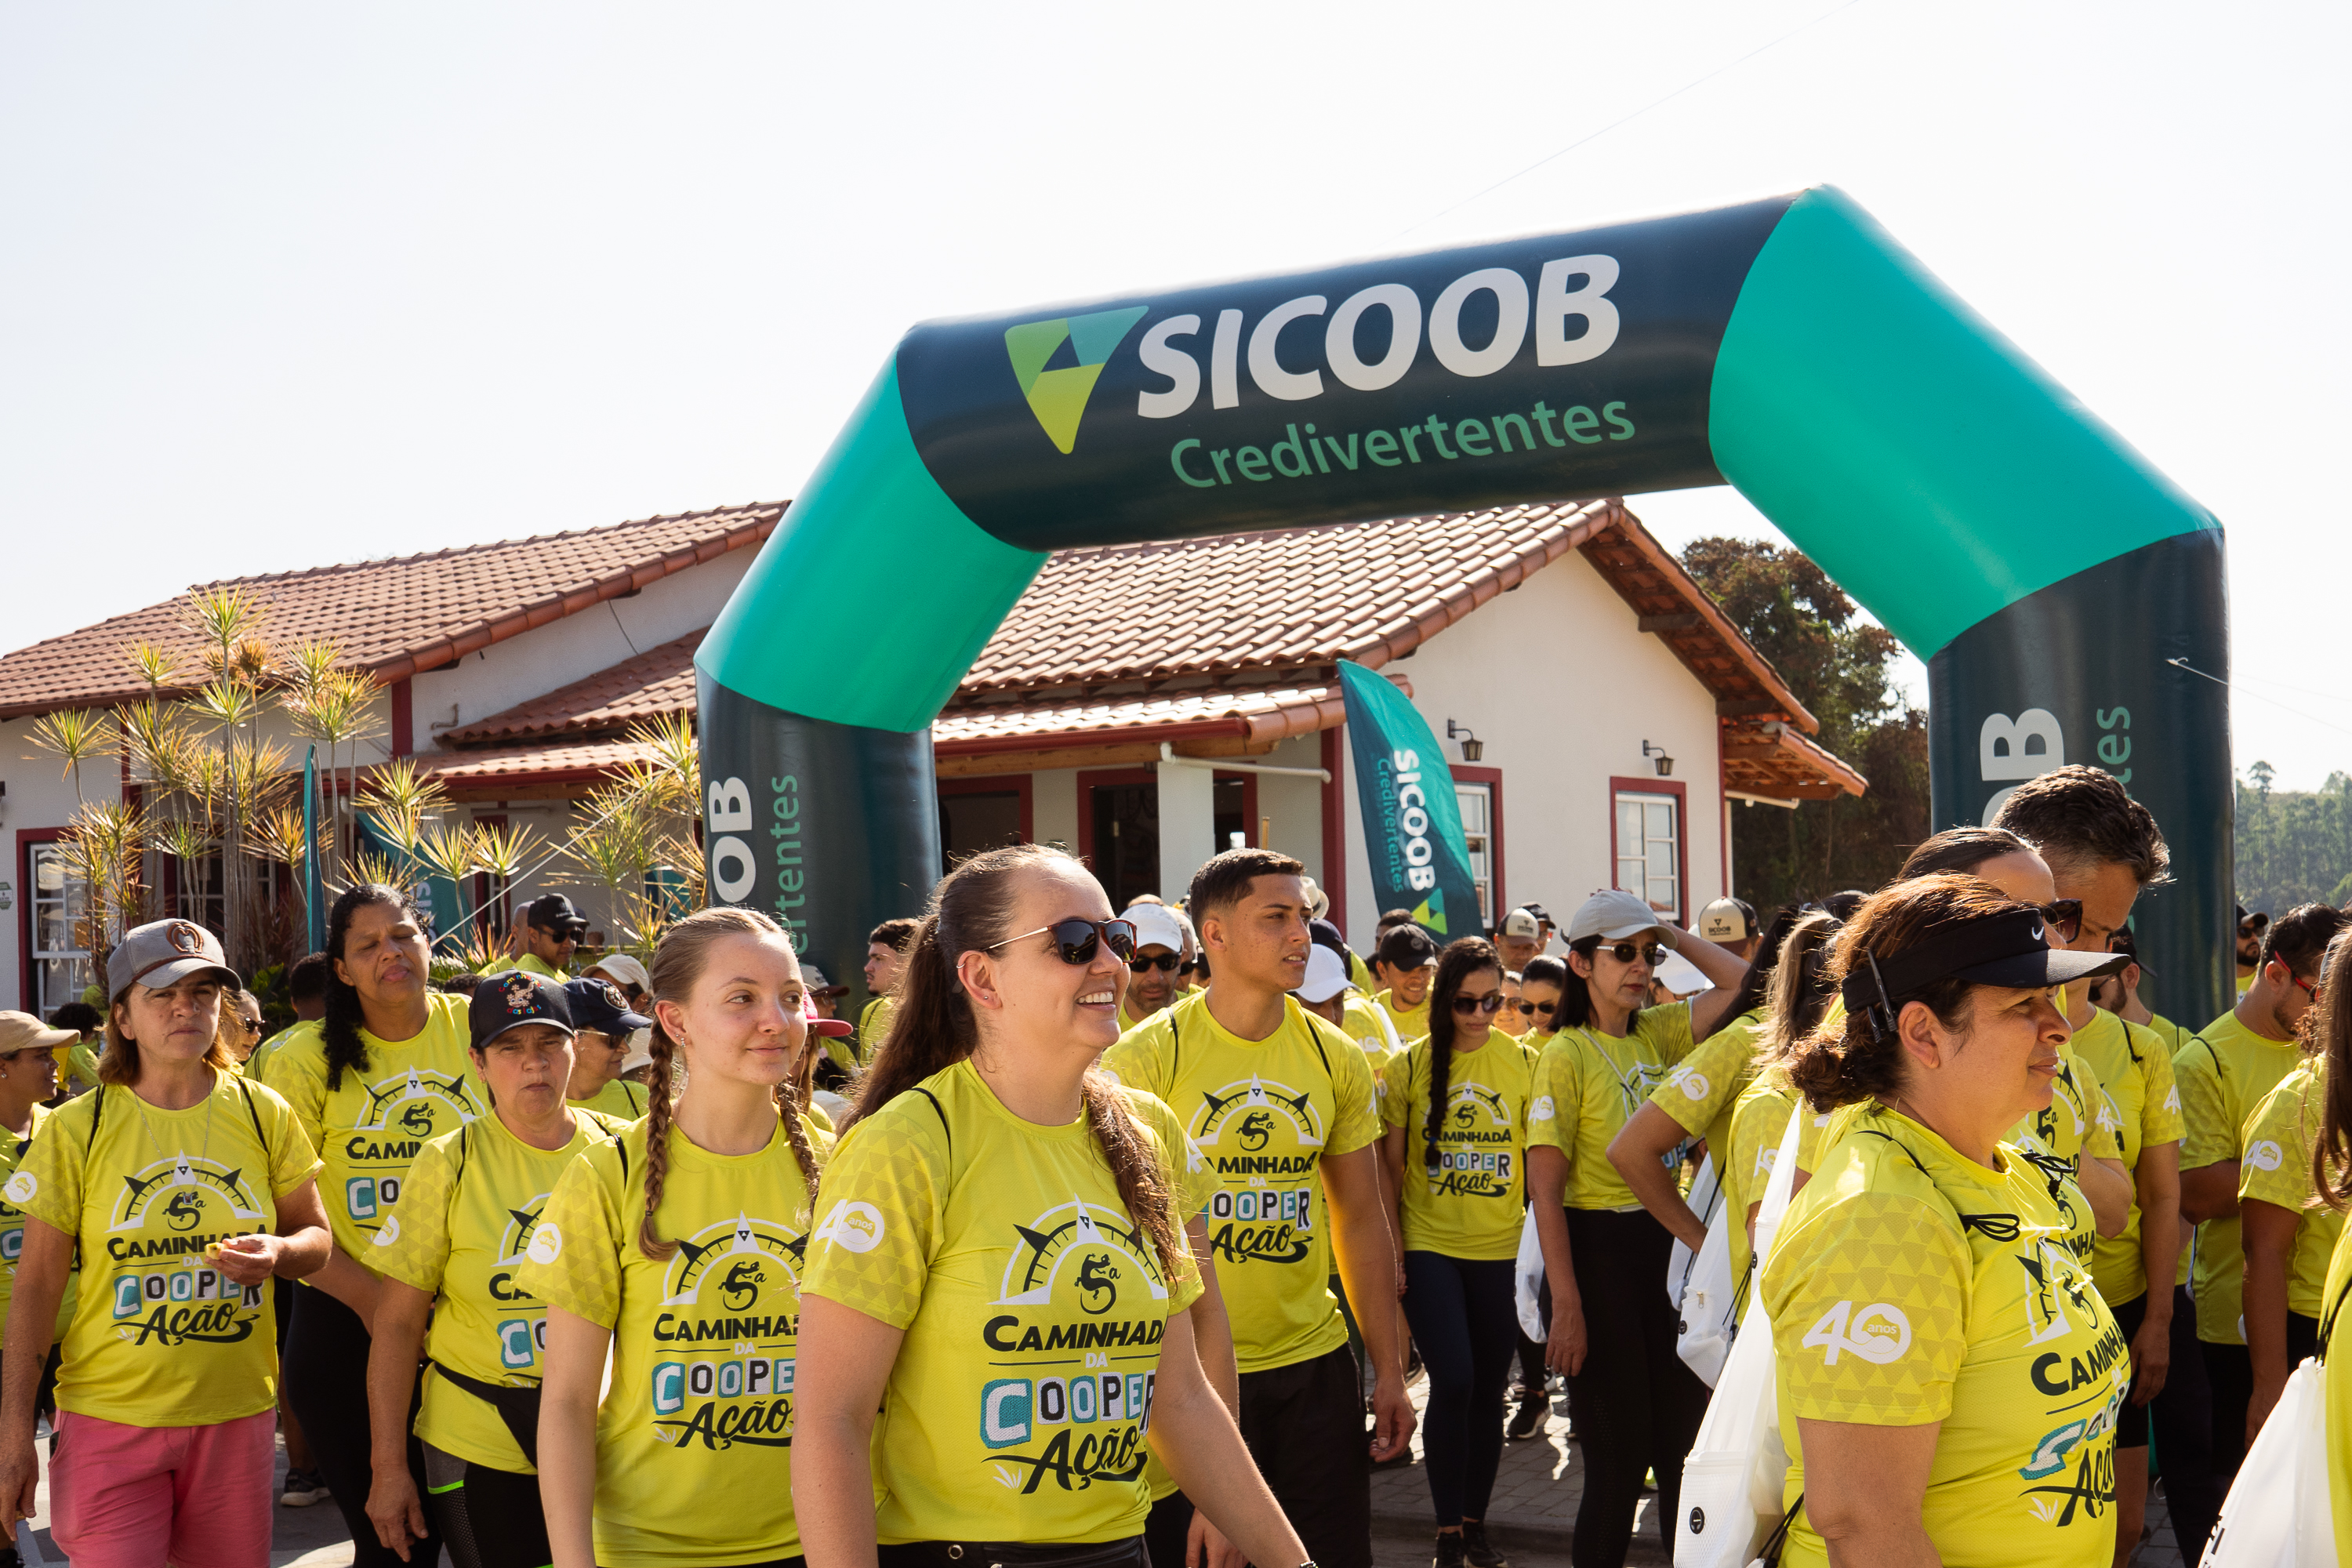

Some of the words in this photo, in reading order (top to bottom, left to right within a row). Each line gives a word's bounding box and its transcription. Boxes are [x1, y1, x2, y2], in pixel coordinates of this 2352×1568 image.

[1138, 254, 1621, 419] SICOOB
[1171, 400, 1636, 488] Credivertentes
[1377, 757, 1403, 893] Credivertentes
[1394, 749, 1436, 891] SICOOB
[770, 775, 808, 955] ertentes
[1421, 1128, 1512, 1142] CMINHADA
[2243, 1140, 2283, 1171] 40
[1249, 1177, 1267, 1187] DA
[1428, 1171, 1494, 1196] Ação
[814, 1199, 884, 1254] 40
[848, 1217, 873, 1230] anos
[1211, 1188, 1312, 1232] OOPER
[183, 1257, 204, 1267] DA
[539, 1234, 557, 1247] anos
[1210, 1223, 1295, 1264] Ação
[111, 1302, 240, 1346] Ação
[653, 1312, 800, 1341] CAMINHA
[982, 1315, 1167, 1352] CAMINHAD
[1801, 1300, 1912, 1366] 40
[1867, 1323, 1897, 1334] anos
[734, 1341, 756, 1355] DA
[1085, 1352, 1109, 1368] DA
[2031, 1320, 2127, 1396] CAMINHA
[652, 1358, 797, 1416] COOPE
[652, 1399, 793, 1451] Ação
[981, 1425, 1142, 1495] Ação
